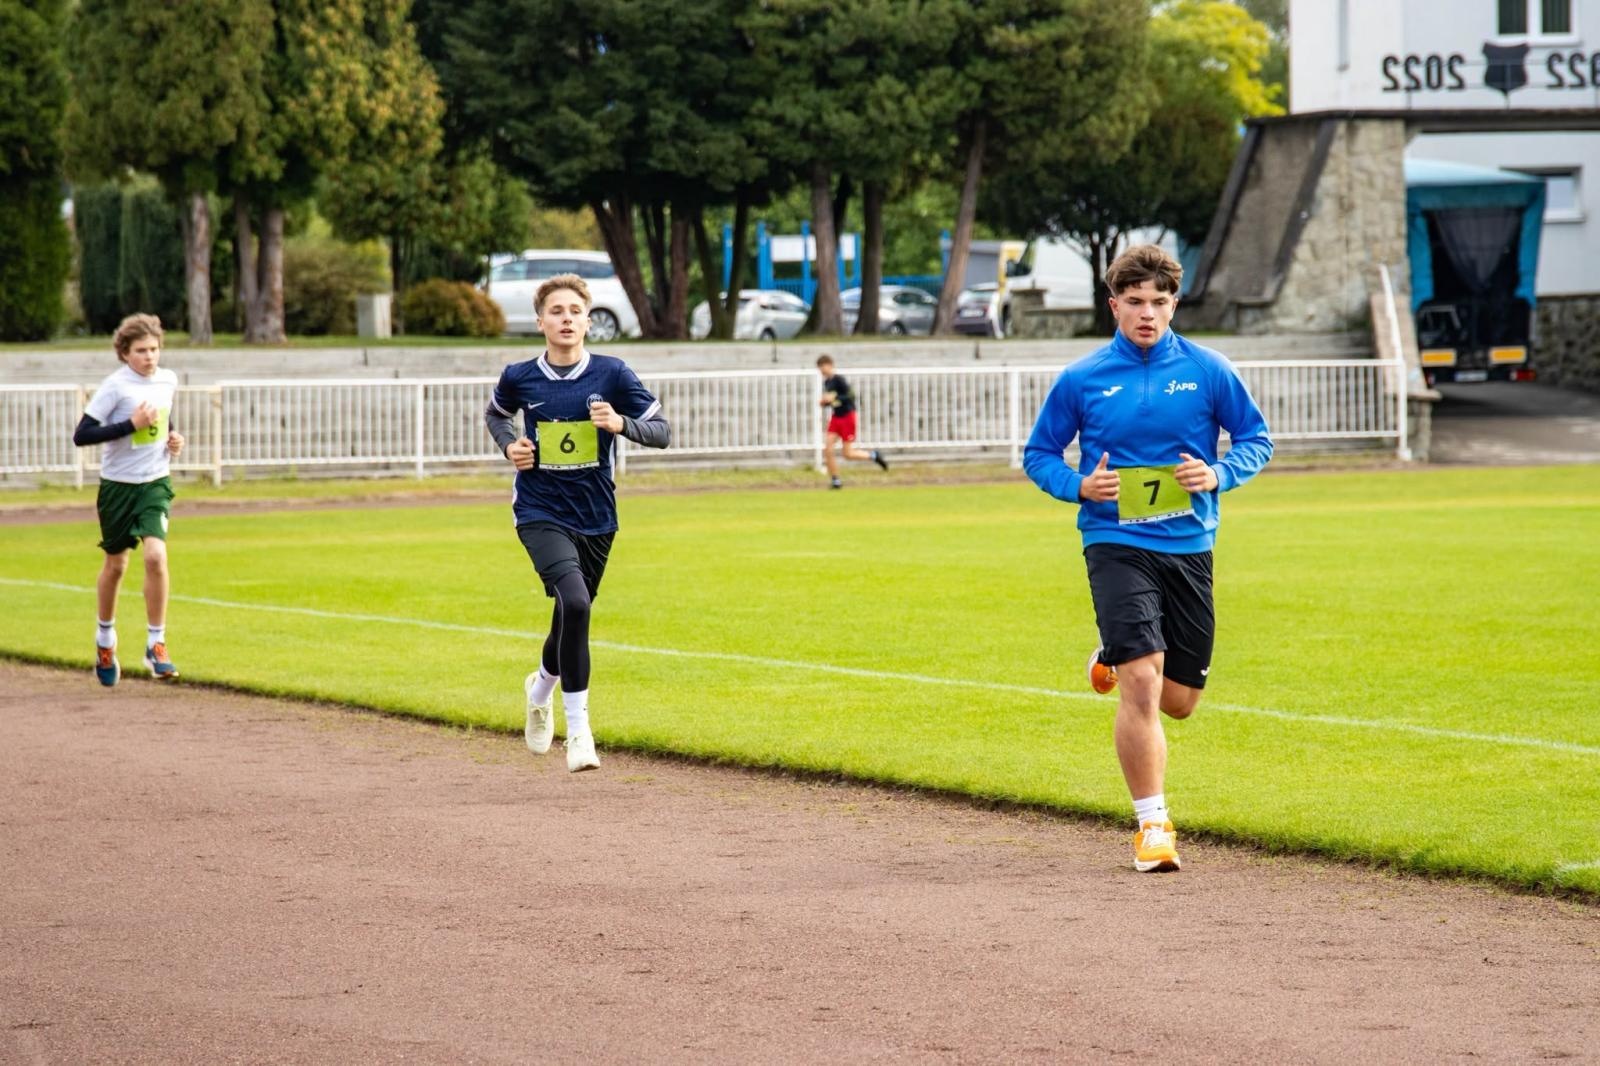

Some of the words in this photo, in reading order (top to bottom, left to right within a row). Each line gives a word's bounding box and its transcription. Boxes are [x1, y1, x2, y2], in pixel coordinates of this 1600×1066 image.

[148, 424, 158, 437] 5
[559, 432, 576, 454] 6
[1143, 479, 1161, 506] 7
